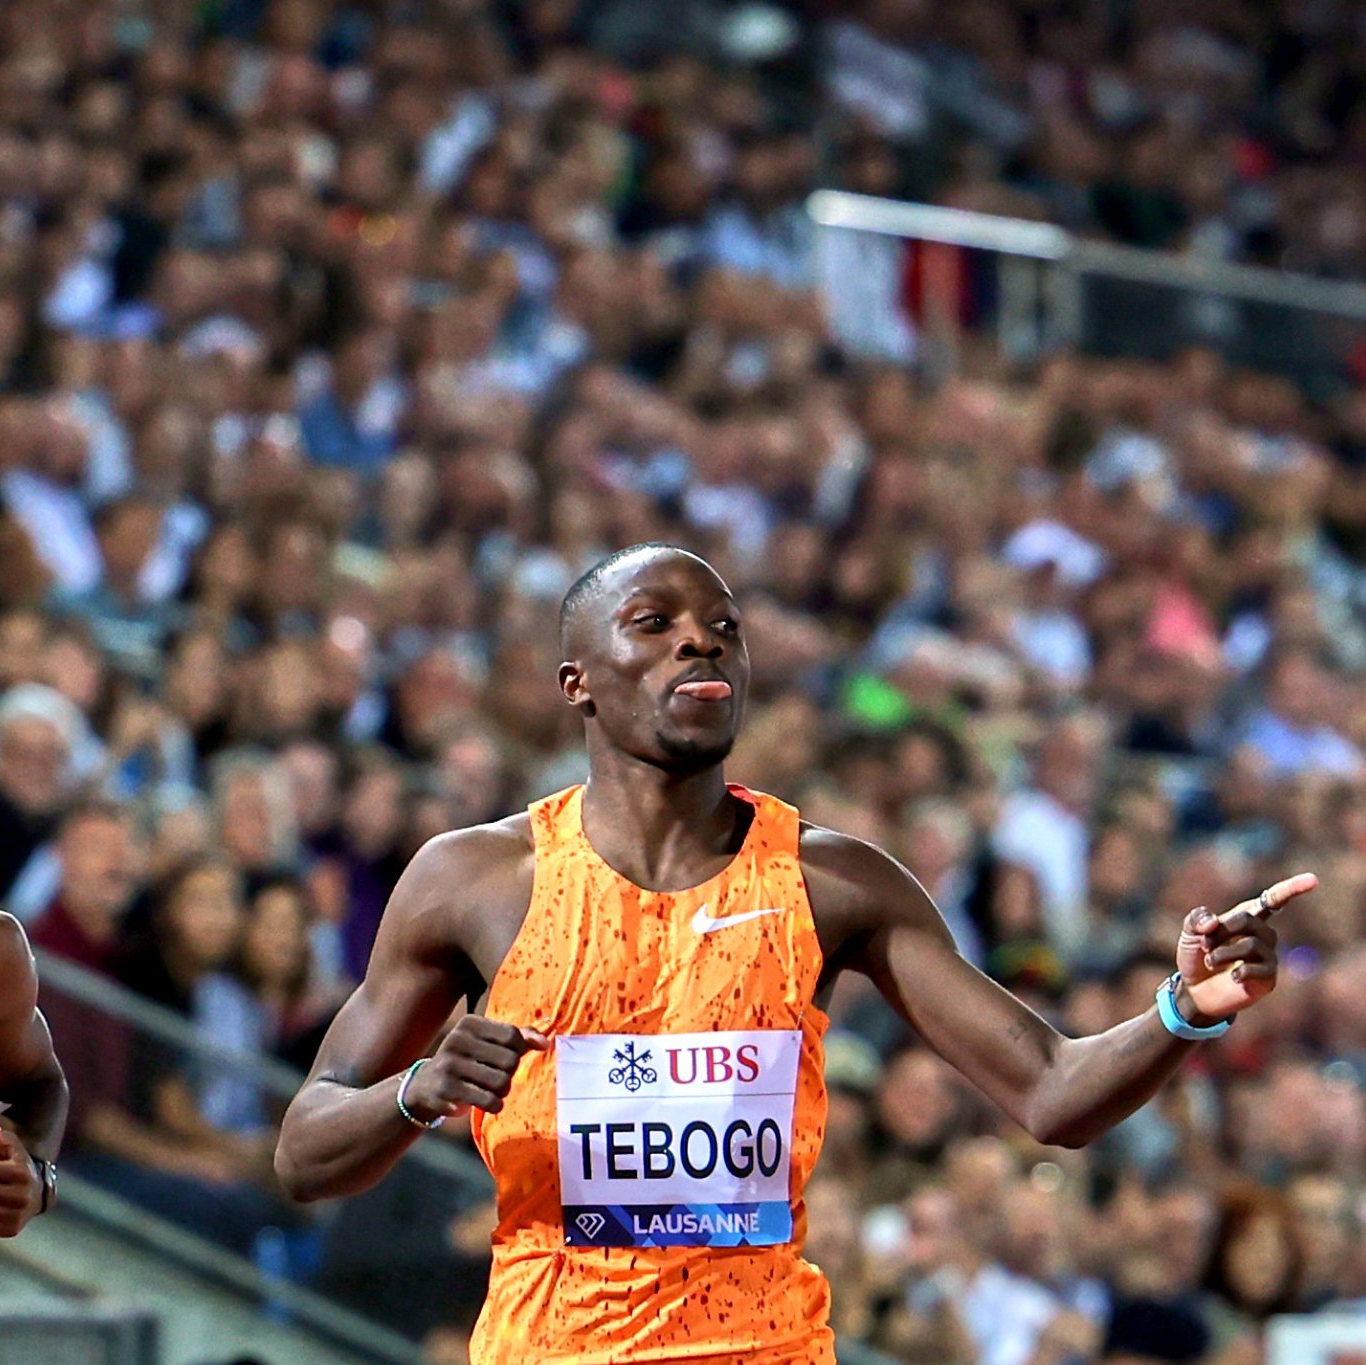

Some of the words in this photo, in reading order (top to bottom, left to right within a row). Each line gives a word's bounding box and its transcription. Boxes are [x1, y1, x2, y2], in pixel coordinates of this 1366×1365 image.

[665, 1044, 760, 1085] UBS
[570, 1118, 782, 1180] TEBOGO
[633, 1213, 760, 1235] LAUSANNE
